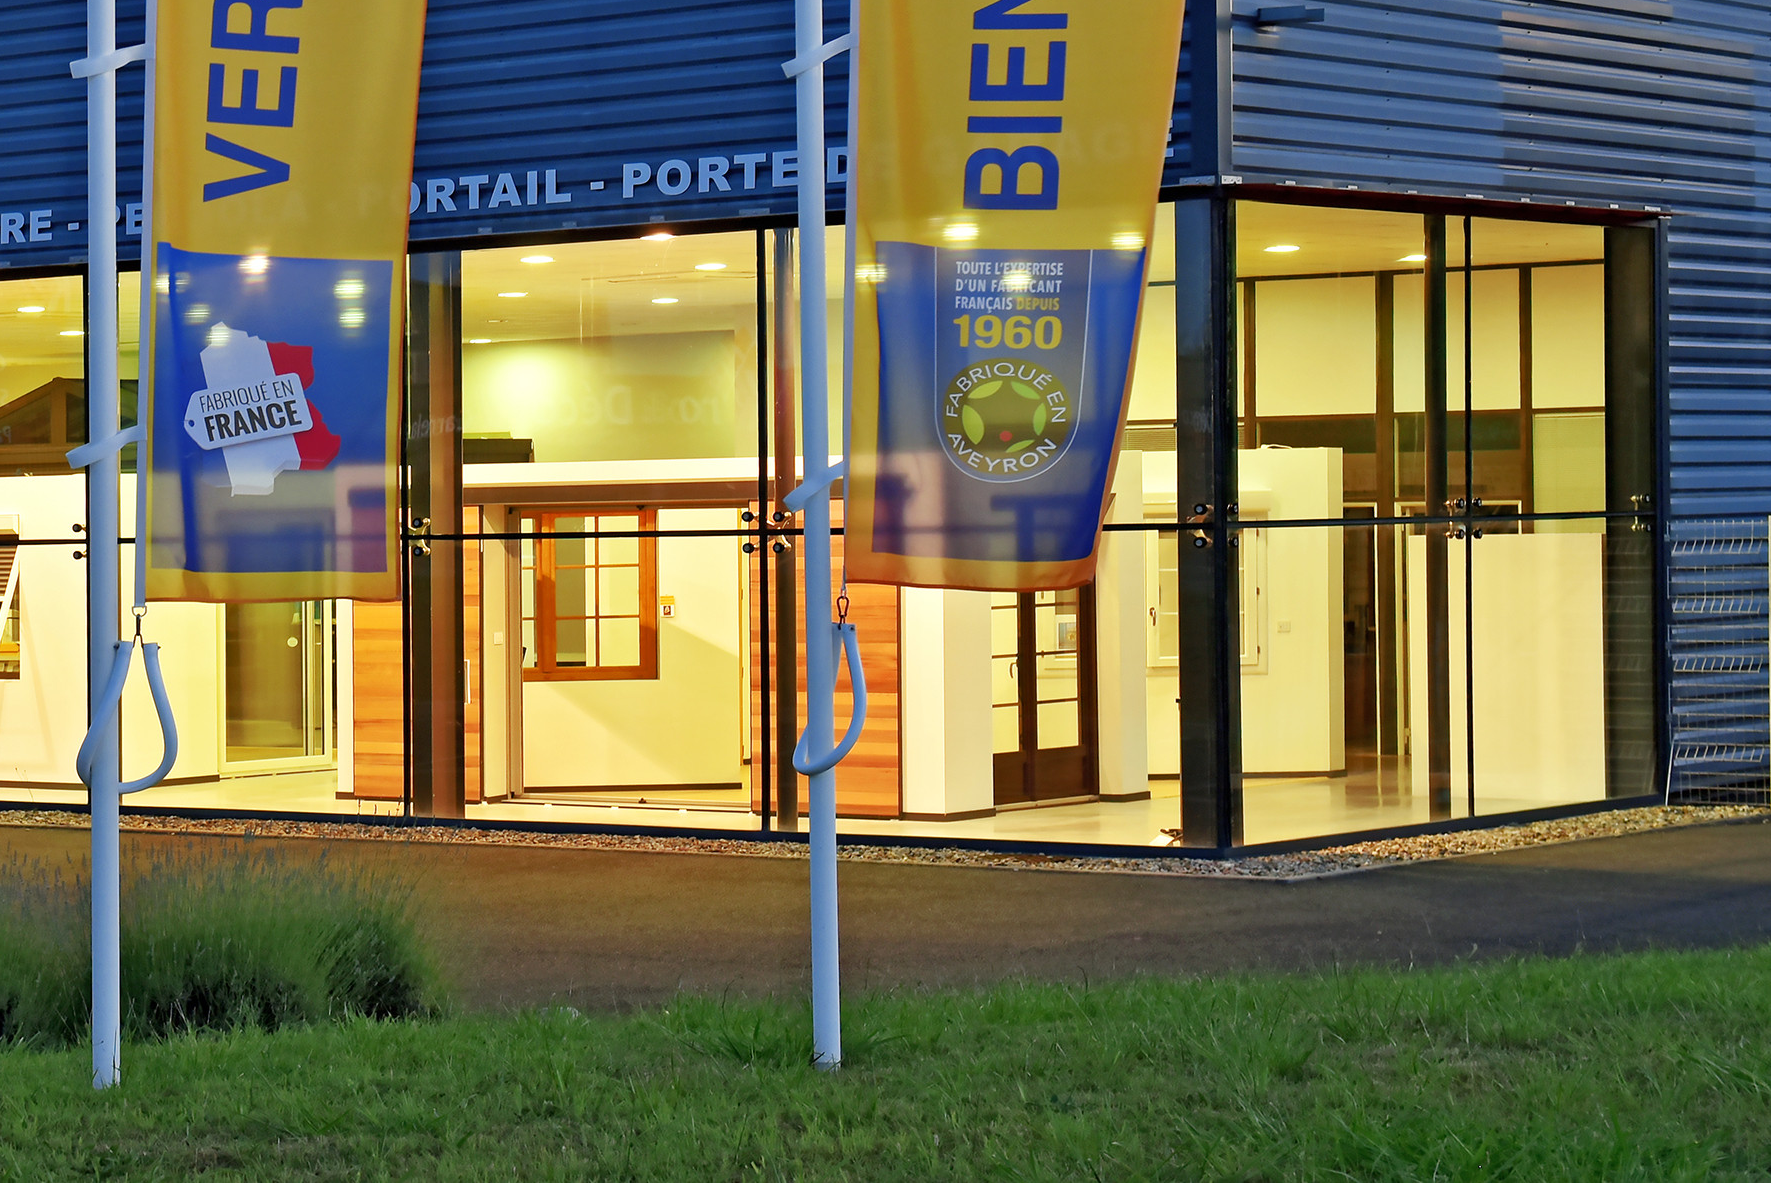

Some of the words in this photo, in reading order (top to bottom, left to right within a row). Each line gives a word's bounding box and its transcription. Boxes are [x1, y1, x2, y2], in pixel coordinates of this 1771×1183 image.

[622, 150, 799, 199] PORTE
[955, 261, 992, 275] TOUTE
[955, 296, 1013, 313] FRANÇAIS
[1016, 297, 1060, 311] DEPUIS
[953, 314, 1063, 350] 1960
[199, 381, 270, 413] FABRIQUÉ
[273, 379, 294, 399] EN
[945, 361, 1054, 418] FABRIQUÉ
[1046, 390, 1067, 424] EN
[204, 400, 302, 442] FRANCE
[947, 431, 1058, 473] AVEYRON
